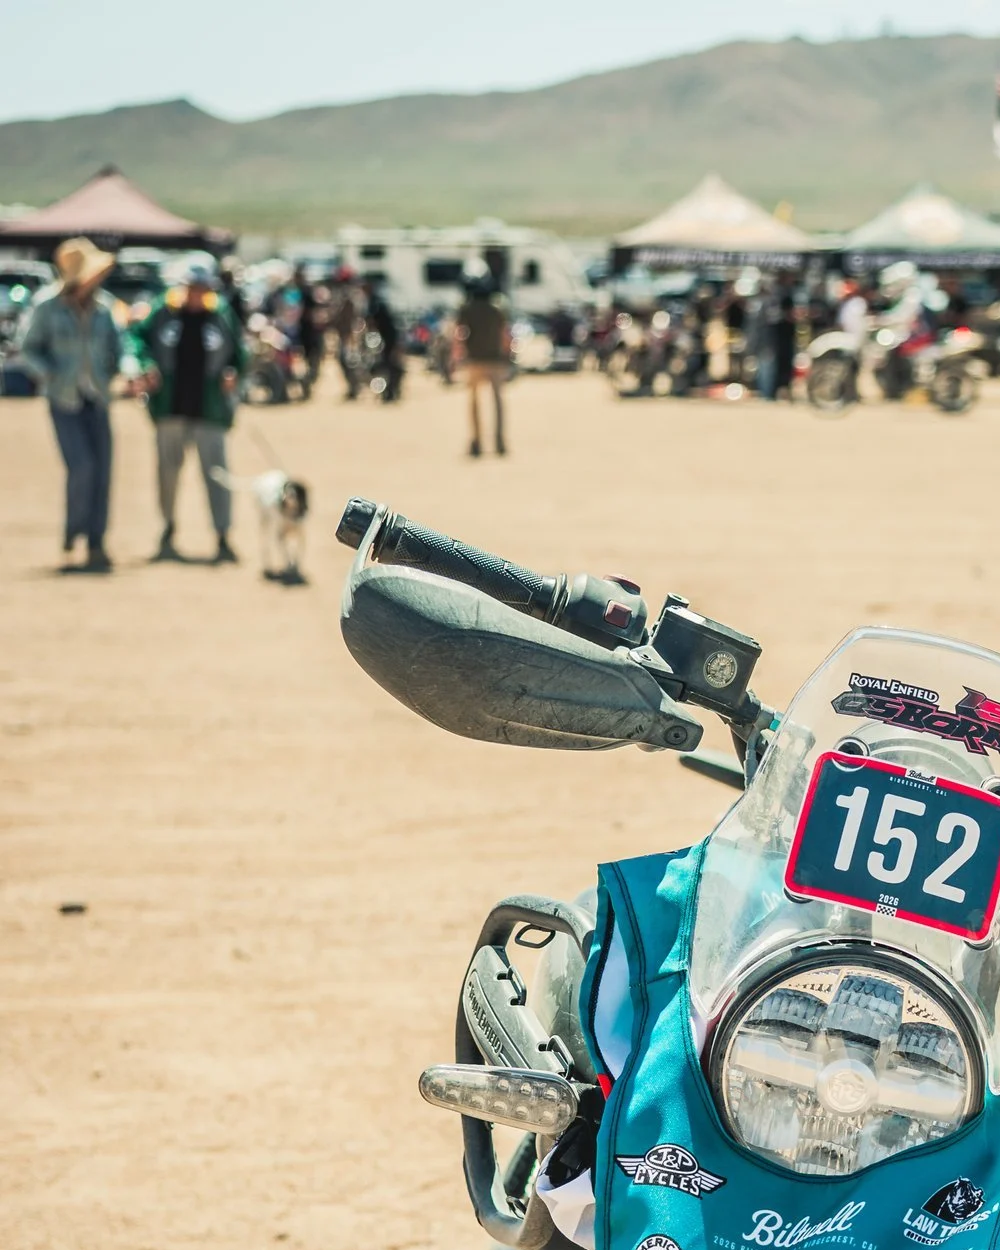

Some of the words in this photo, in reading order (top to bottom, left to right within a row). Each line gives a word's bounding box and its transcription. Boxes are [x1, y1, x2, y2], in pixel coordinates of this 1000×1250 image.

[850, 674, 888, 691] ROYAL
[889, 680, 939, 703] ENFIELD
[833, 786, 981, 904] 152
[878, 893, 899, 906] 2026
[649, 1147, 693, 1170] J&P
[634, 1164, 701, 1197] CYCLES
[742, 1200, 866, 1248] Biltwell
[902, 1207, 939, 1236] LAW
[713, 1235, 736, 1250] 2026
